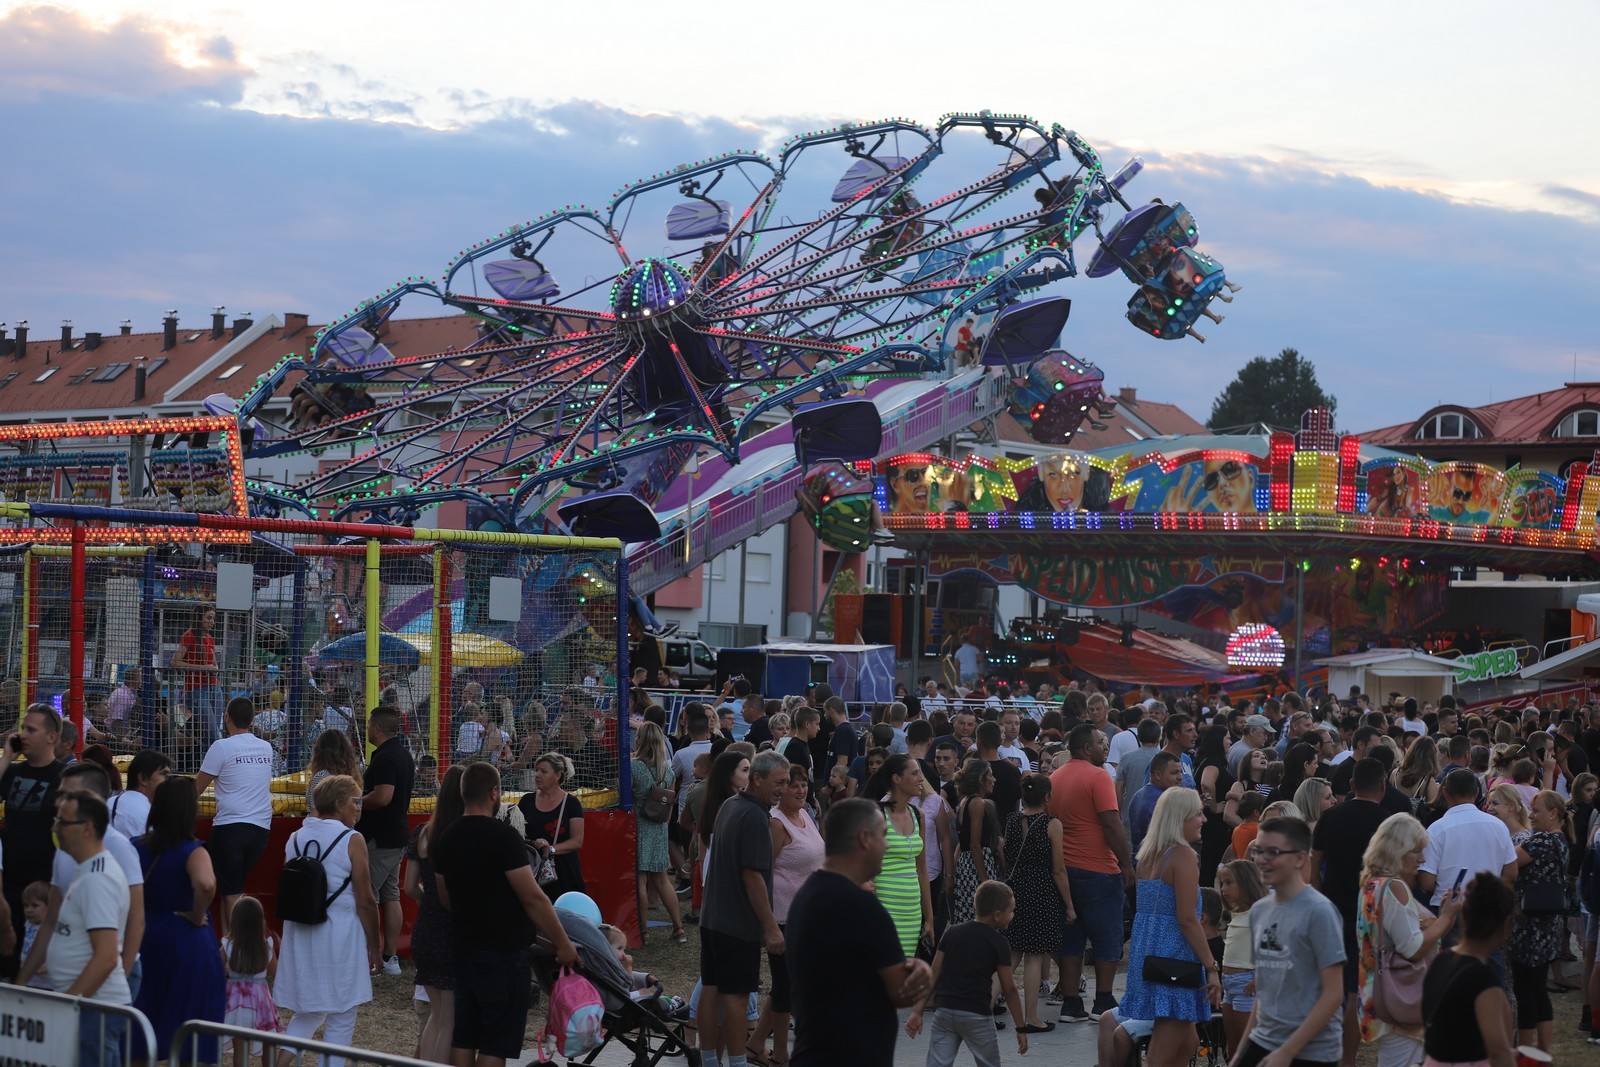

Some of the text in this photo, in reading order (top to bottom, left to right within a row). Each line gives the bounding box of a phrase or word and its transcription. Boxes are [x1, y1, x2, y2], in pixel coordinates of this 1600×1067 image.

[1016, 552, 1098, 604] SPEED
[1453, 648, 1518, 681] SUPER
[1, 1012, 46, 1043] JE POD
